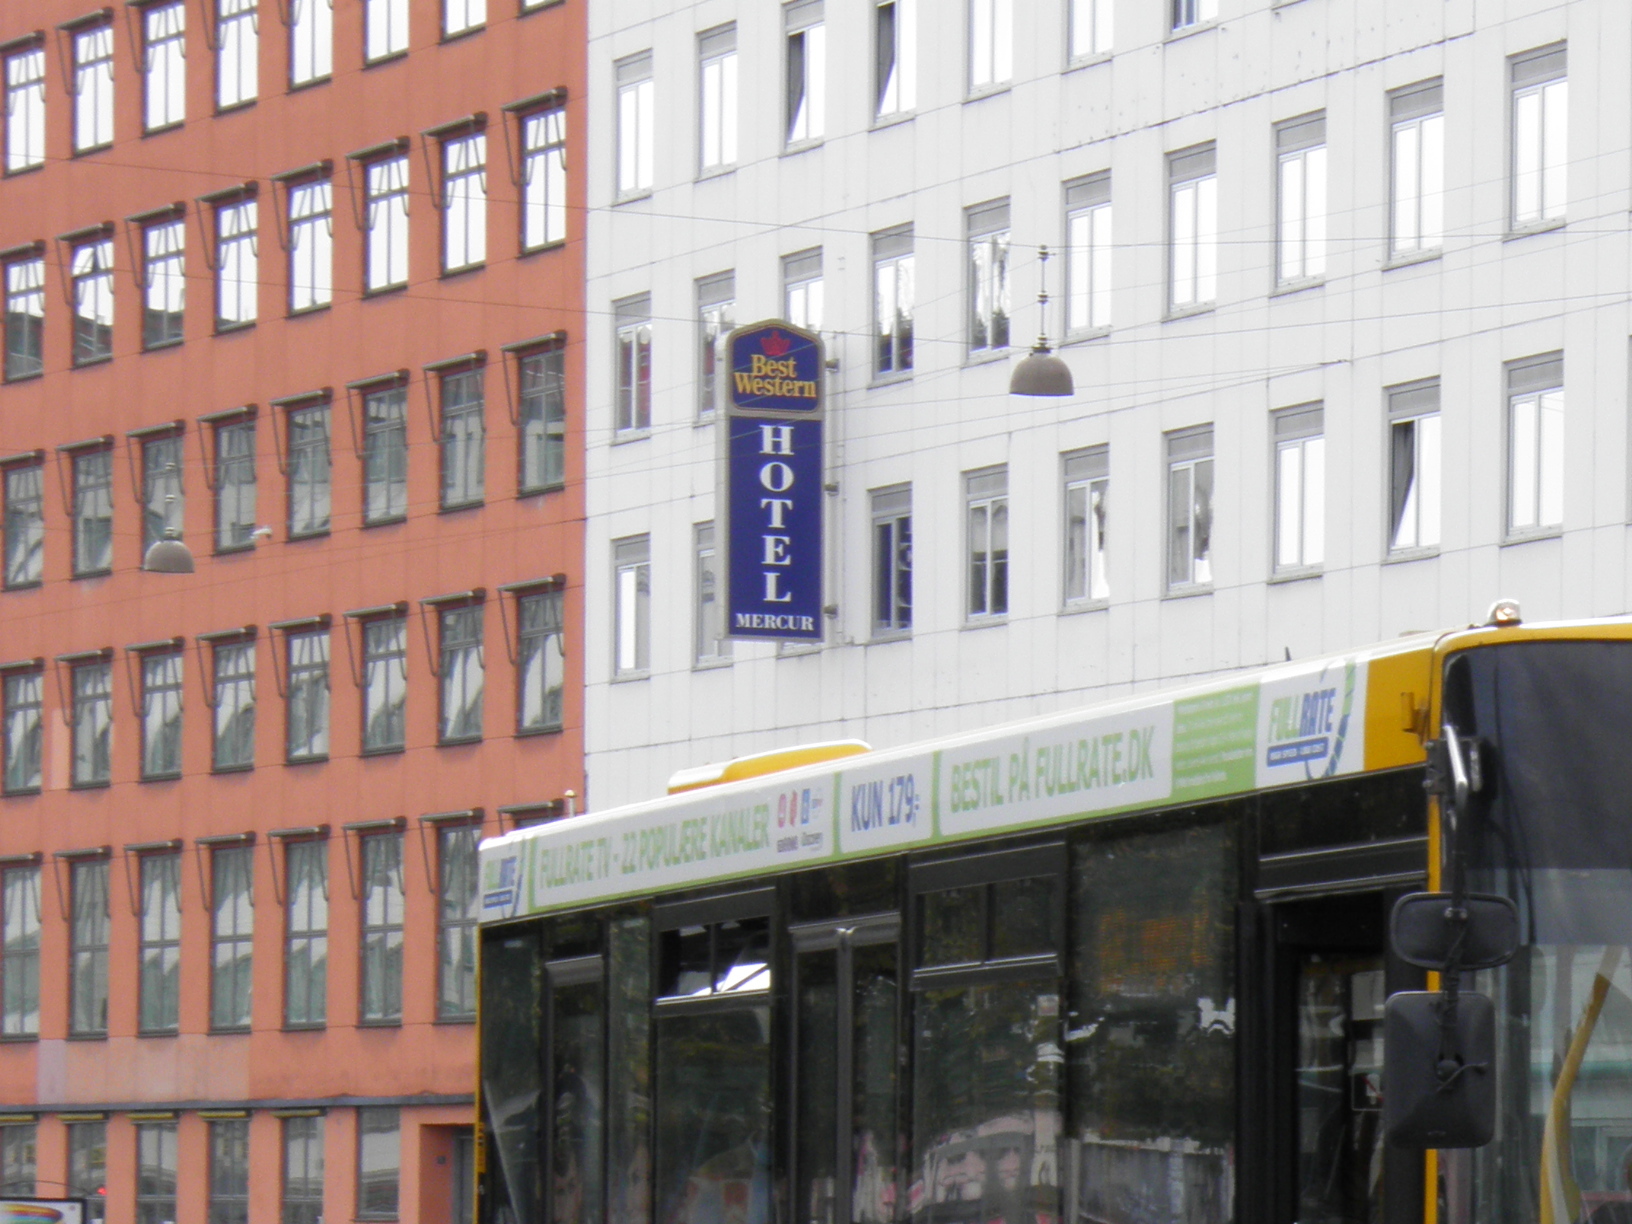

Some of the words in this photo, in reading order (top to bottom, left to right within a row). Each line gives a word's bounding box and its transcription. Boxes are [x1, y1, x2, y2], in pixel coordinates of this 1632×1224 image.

[734, 372, 817, 398] Western
[752, 354, 797, 378] Best
[759, 424, 794, 602] HOTEL
[736, 613, 814, 631] MERCUR
[951, 756, 1004, 813] BESTIL
[1009, 736, 1030, 804] PÅ
[1035, 725, 1155, 799] FULLRATE.DK
[851, 780, 883, 832] KUN
[541, 840, 595, 889] FULLRATE
[597, 836, 613, 880] TV
[621, 831, 636, 876] 22
[639, 817, 707, 871] POPULÆRE
[709, 803, 770, 859] KANALER
